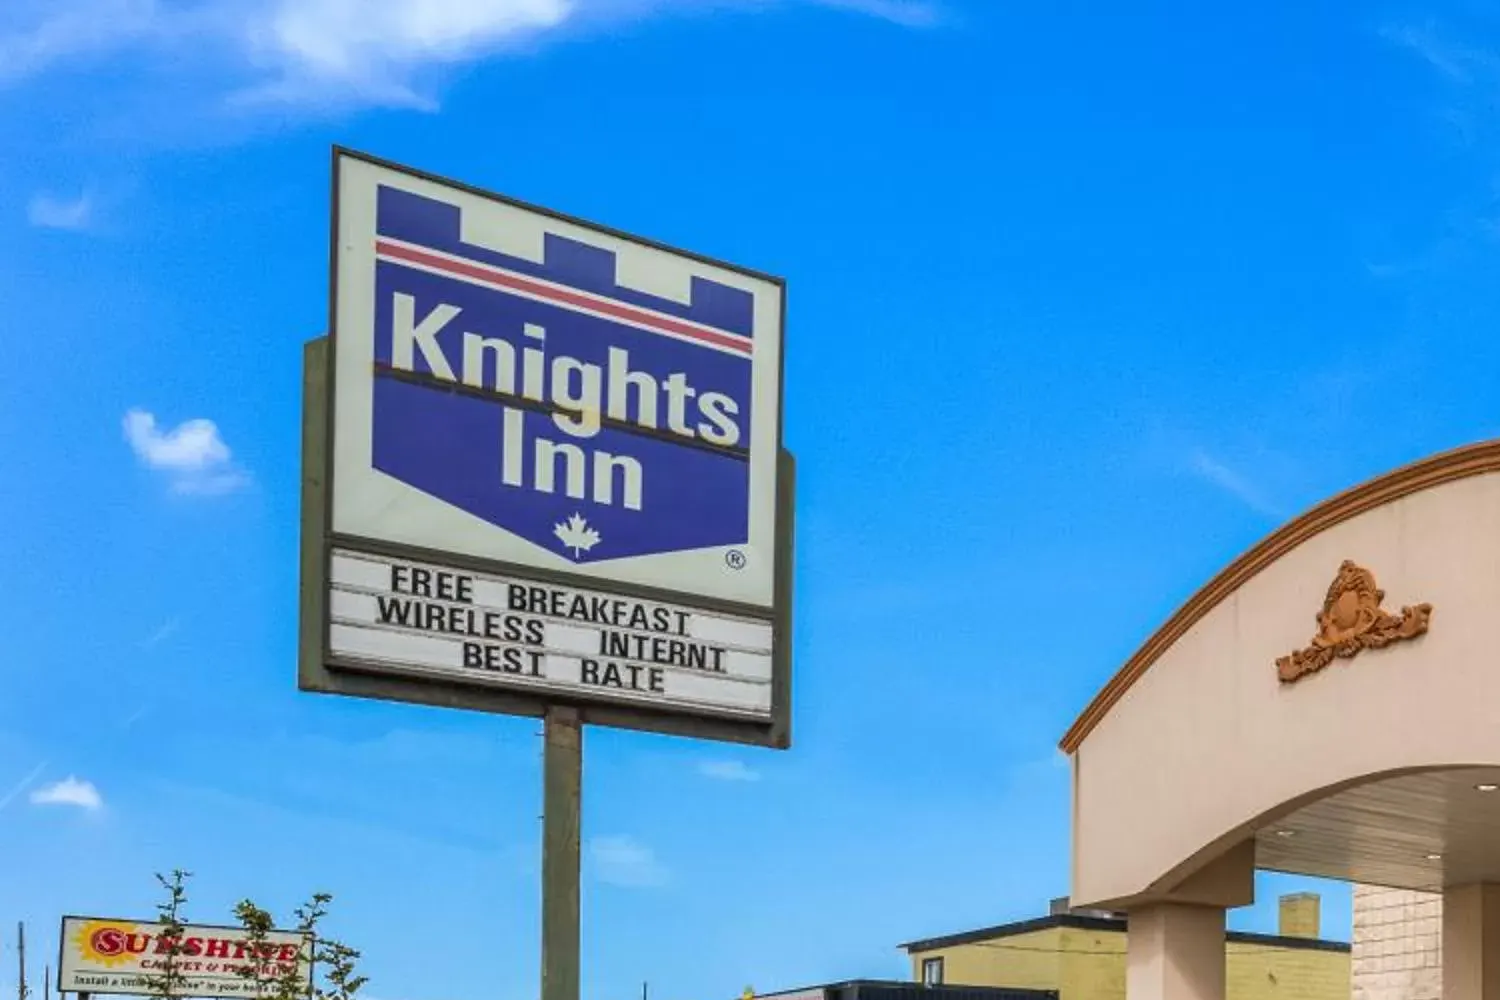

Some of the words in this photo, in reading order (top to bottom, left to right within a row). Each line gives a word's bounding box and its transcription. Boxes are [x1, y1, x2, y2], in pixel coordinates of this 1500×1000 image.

[391, 292, 741, 447] Knights
[502, 407, 643, 511] Inn
[376, 596, 545, 646] WIRELESS
[601, 630, 727, 673] INTERNT
[391, 565, 473, 602] FREE
[508, 583, 691, 636] BREAKFAST
[462, 642, 546, 677] BEST
[581, 659, 665, 692] RATE
